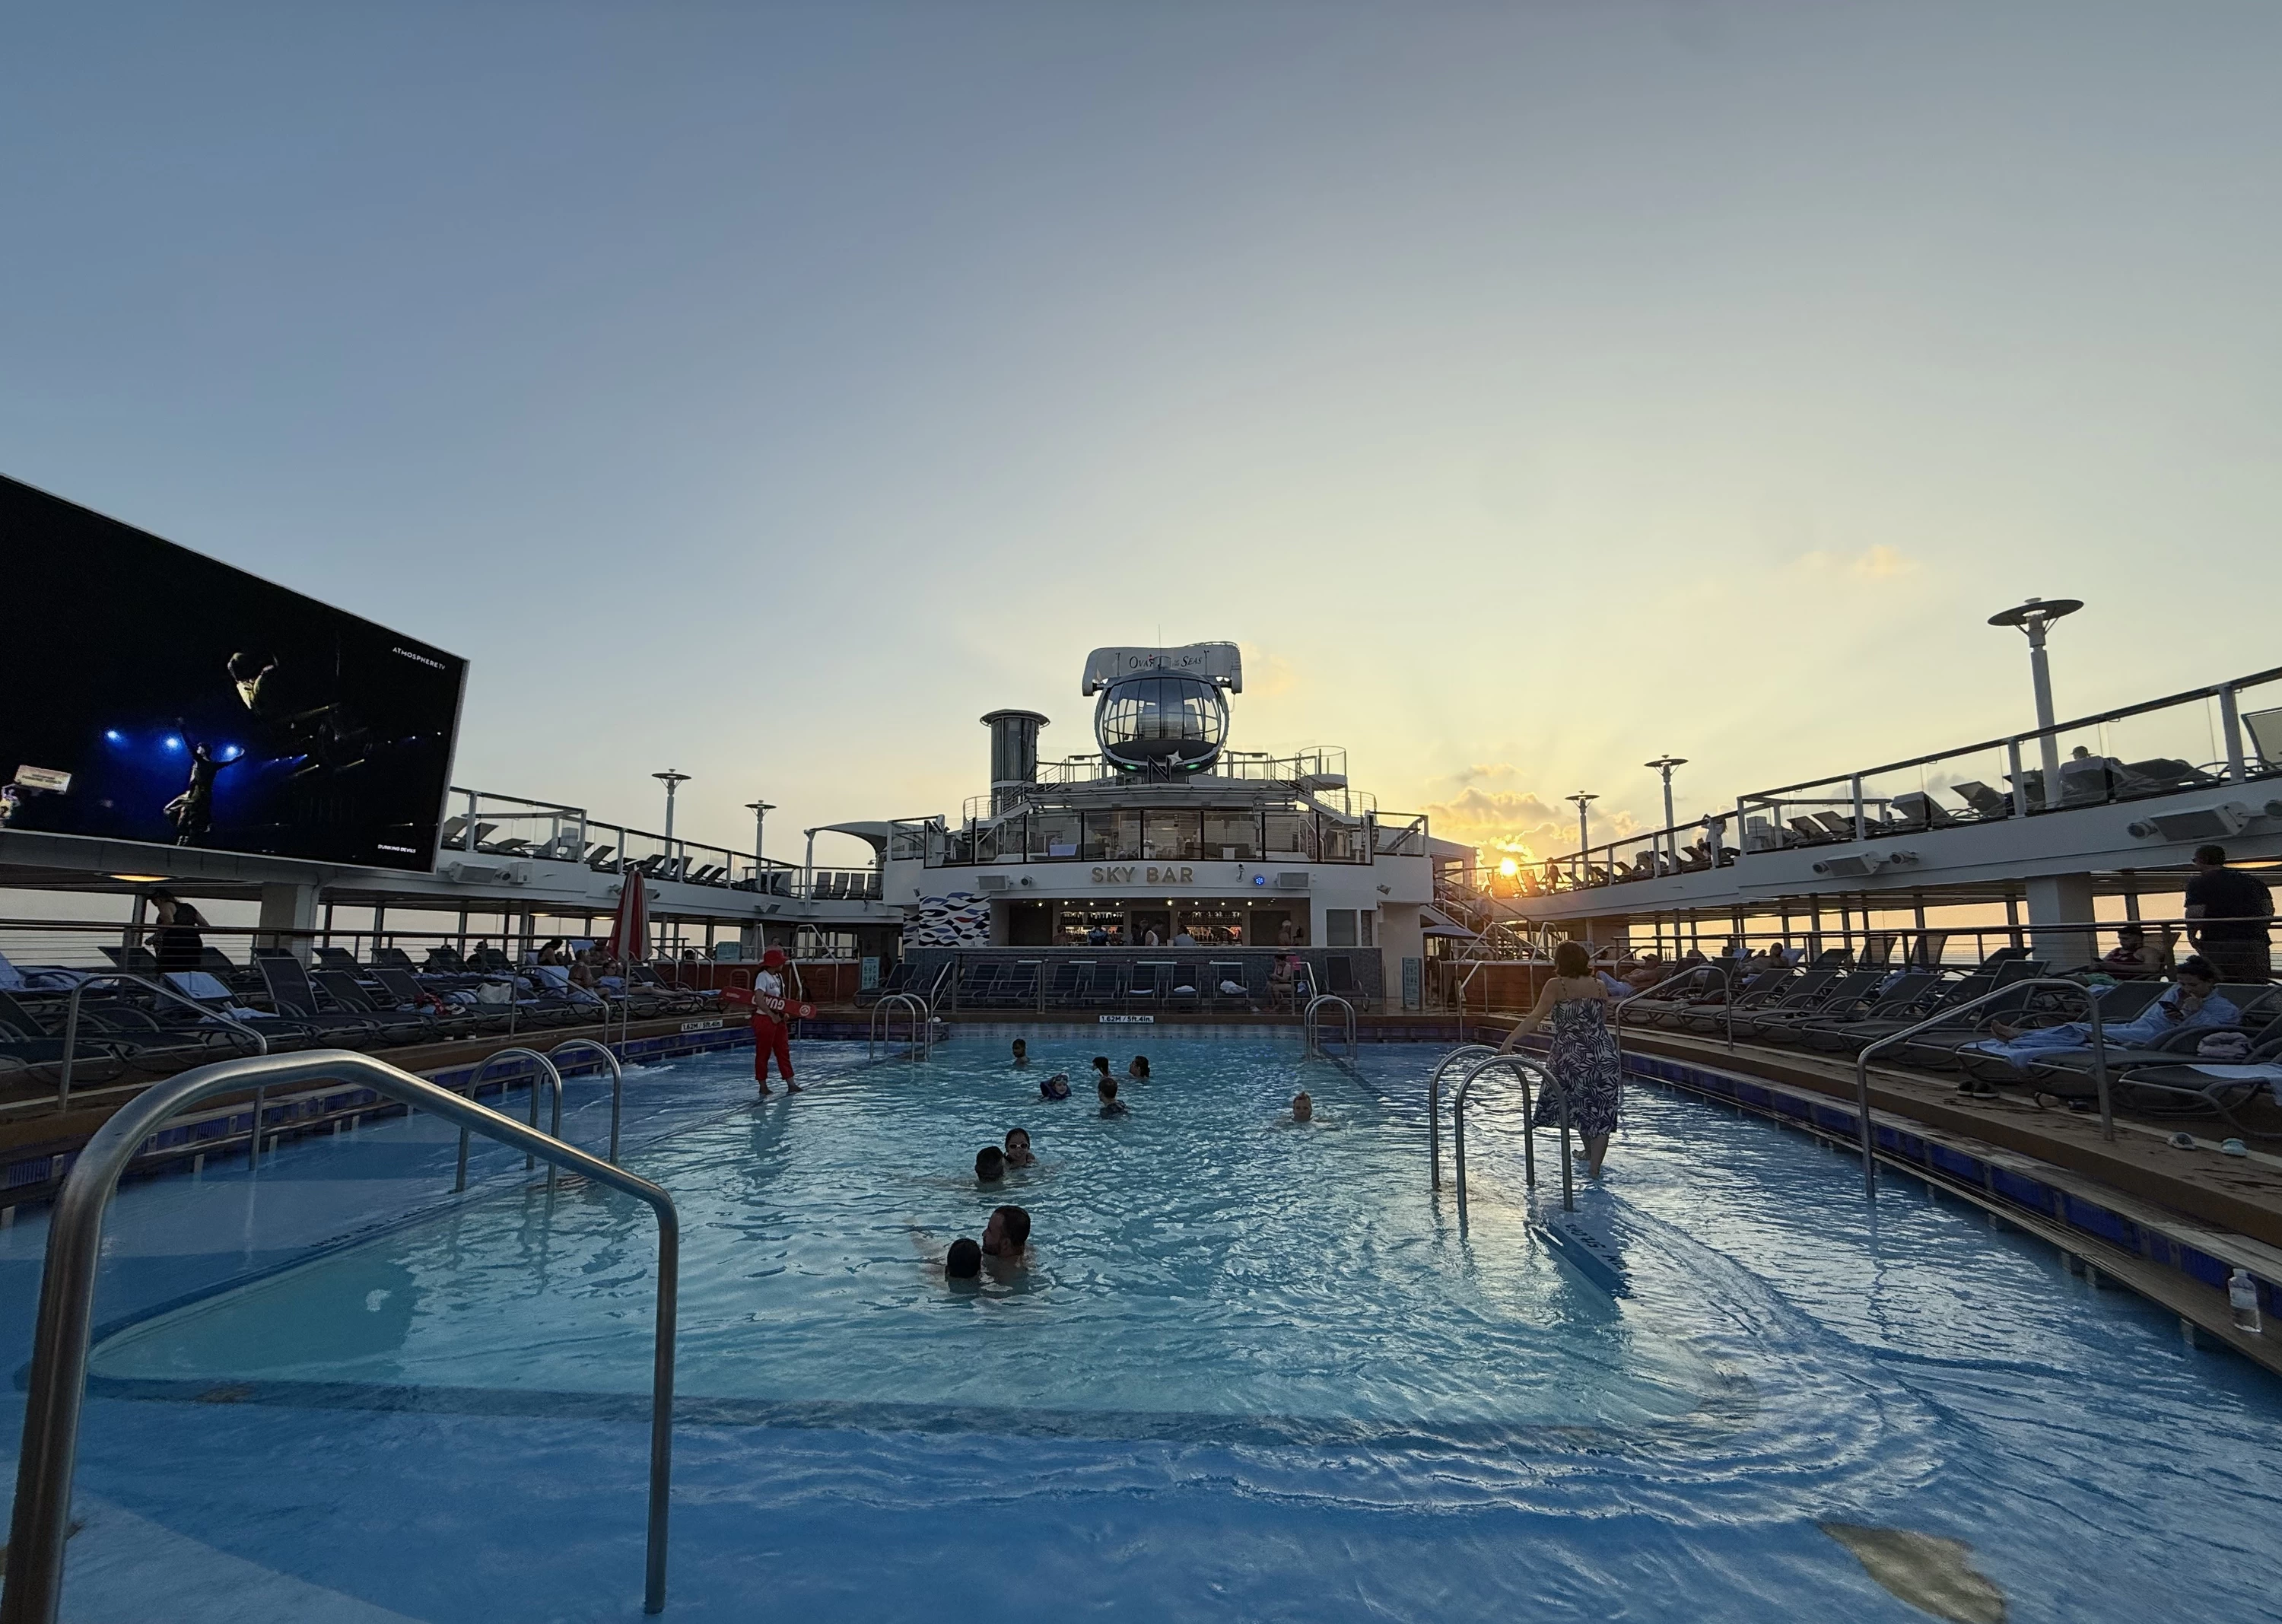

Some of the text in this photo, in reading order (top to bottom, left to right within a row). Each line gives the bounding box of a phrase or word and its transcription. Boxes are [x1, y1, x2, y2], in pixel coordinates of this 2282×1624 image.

[1181, 656, 1202, 667] SEAS
[1092, 866, 1193, 883] SKY BAR
